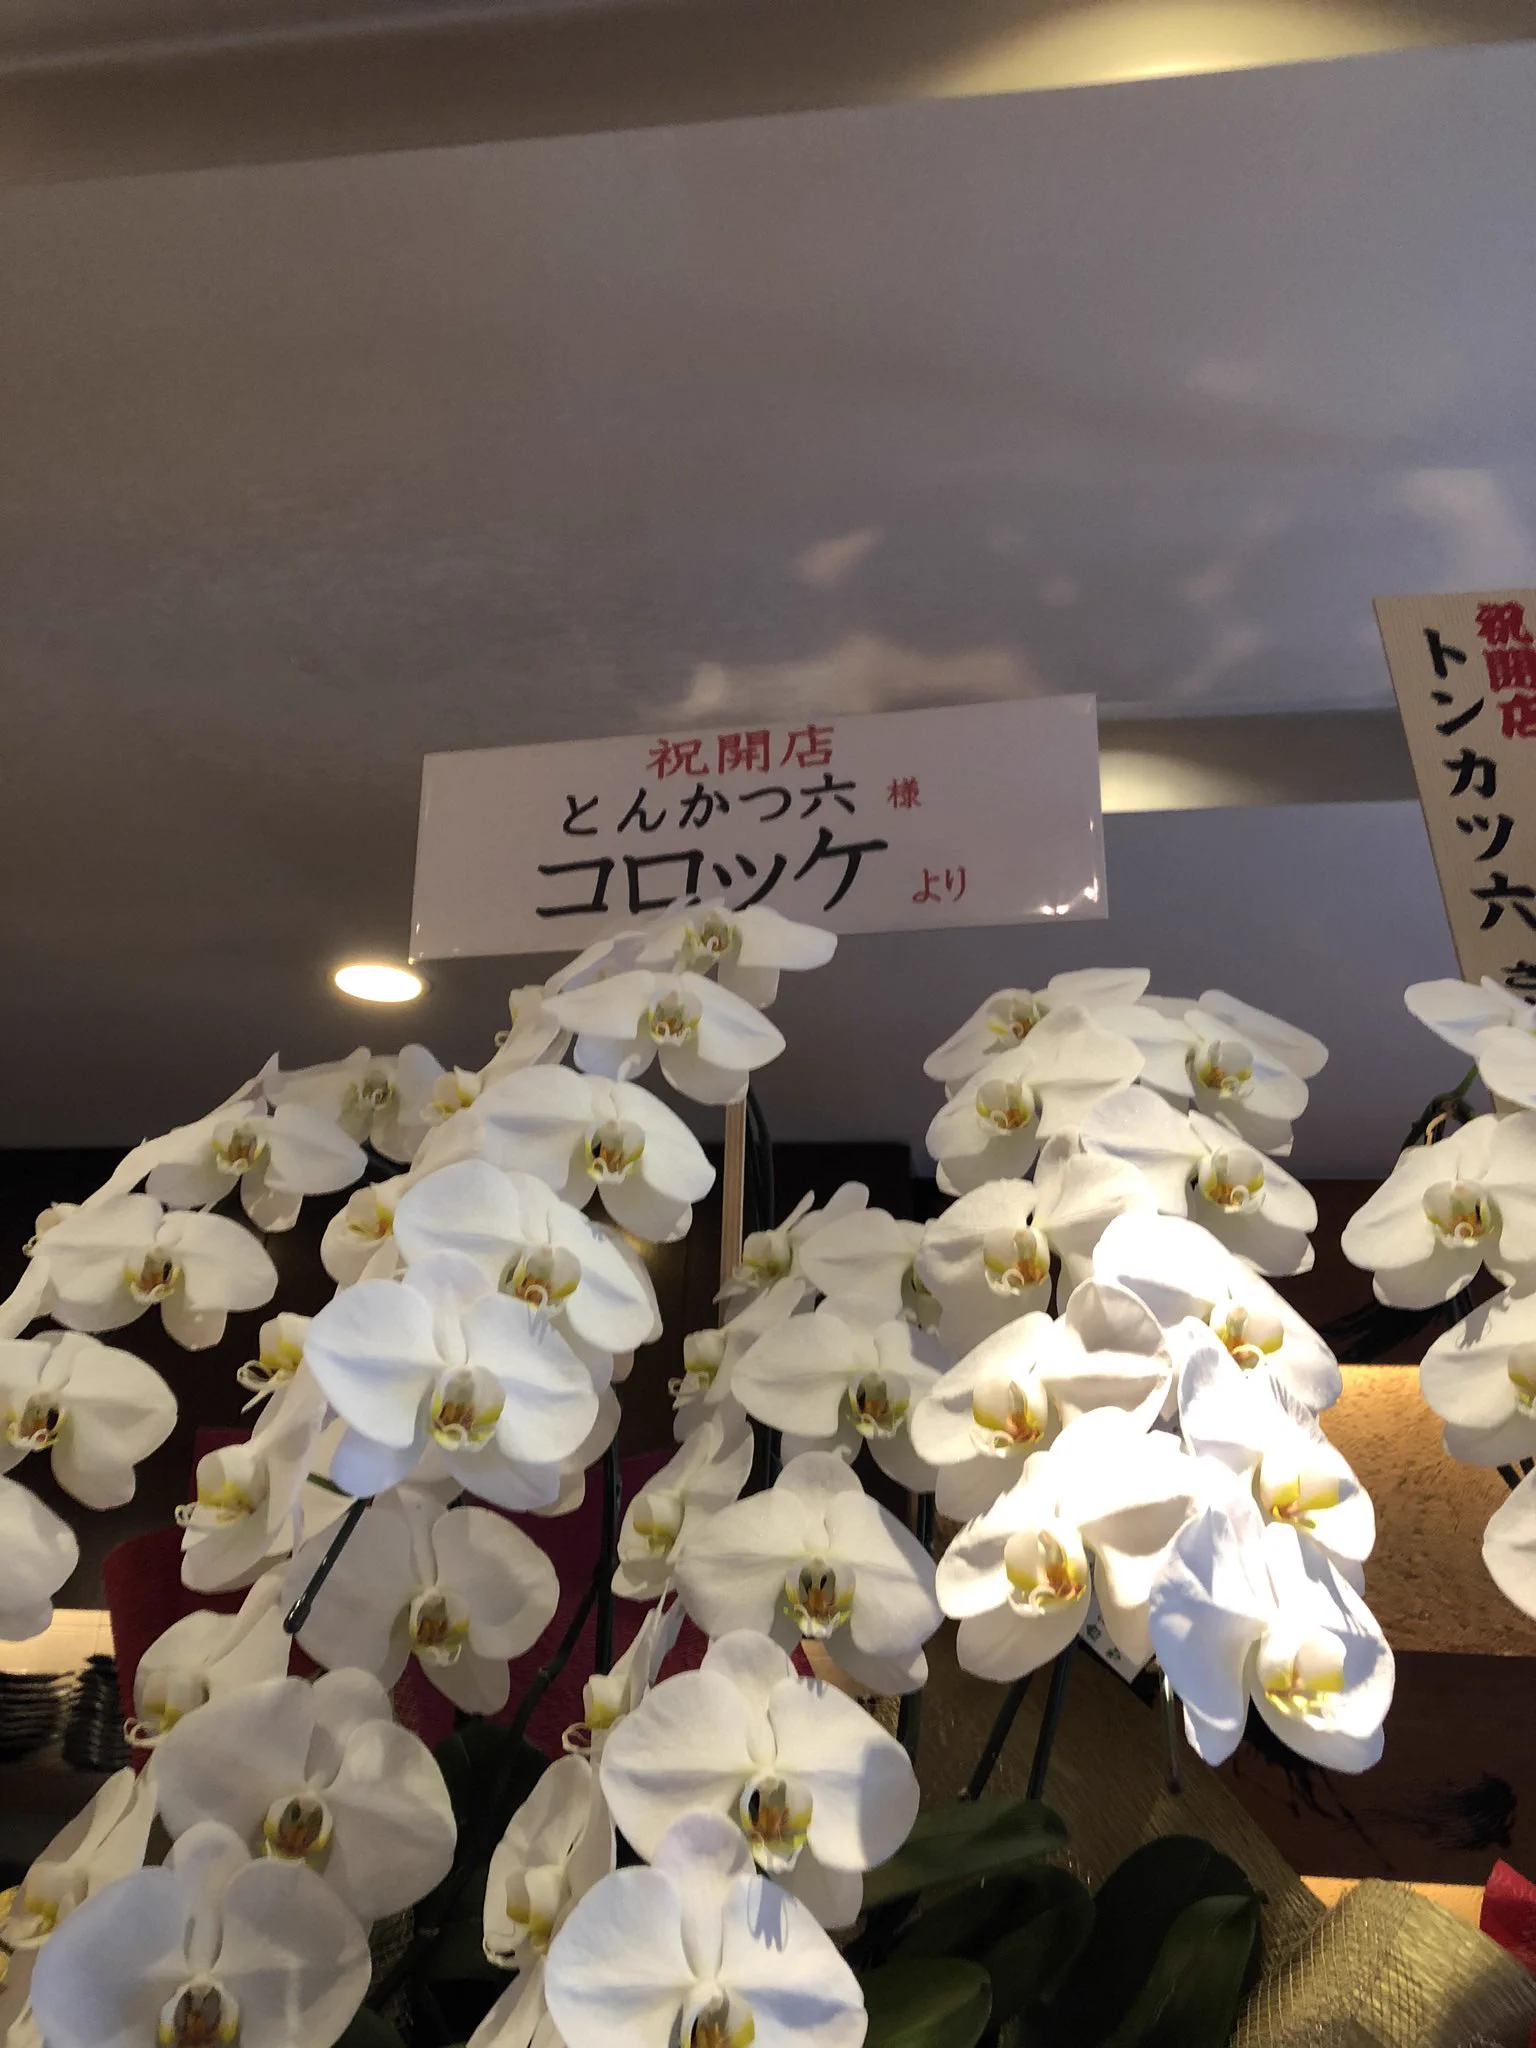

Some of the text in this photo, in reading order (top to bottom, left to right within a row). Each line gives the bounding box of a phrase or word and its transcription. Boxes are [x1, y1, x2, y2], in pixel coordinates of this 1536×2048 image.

[648, 725, 836, 778] 祝開店
[562, 773, 922, 836] とんかつ六 様
[912, 866, 967, 904] より
